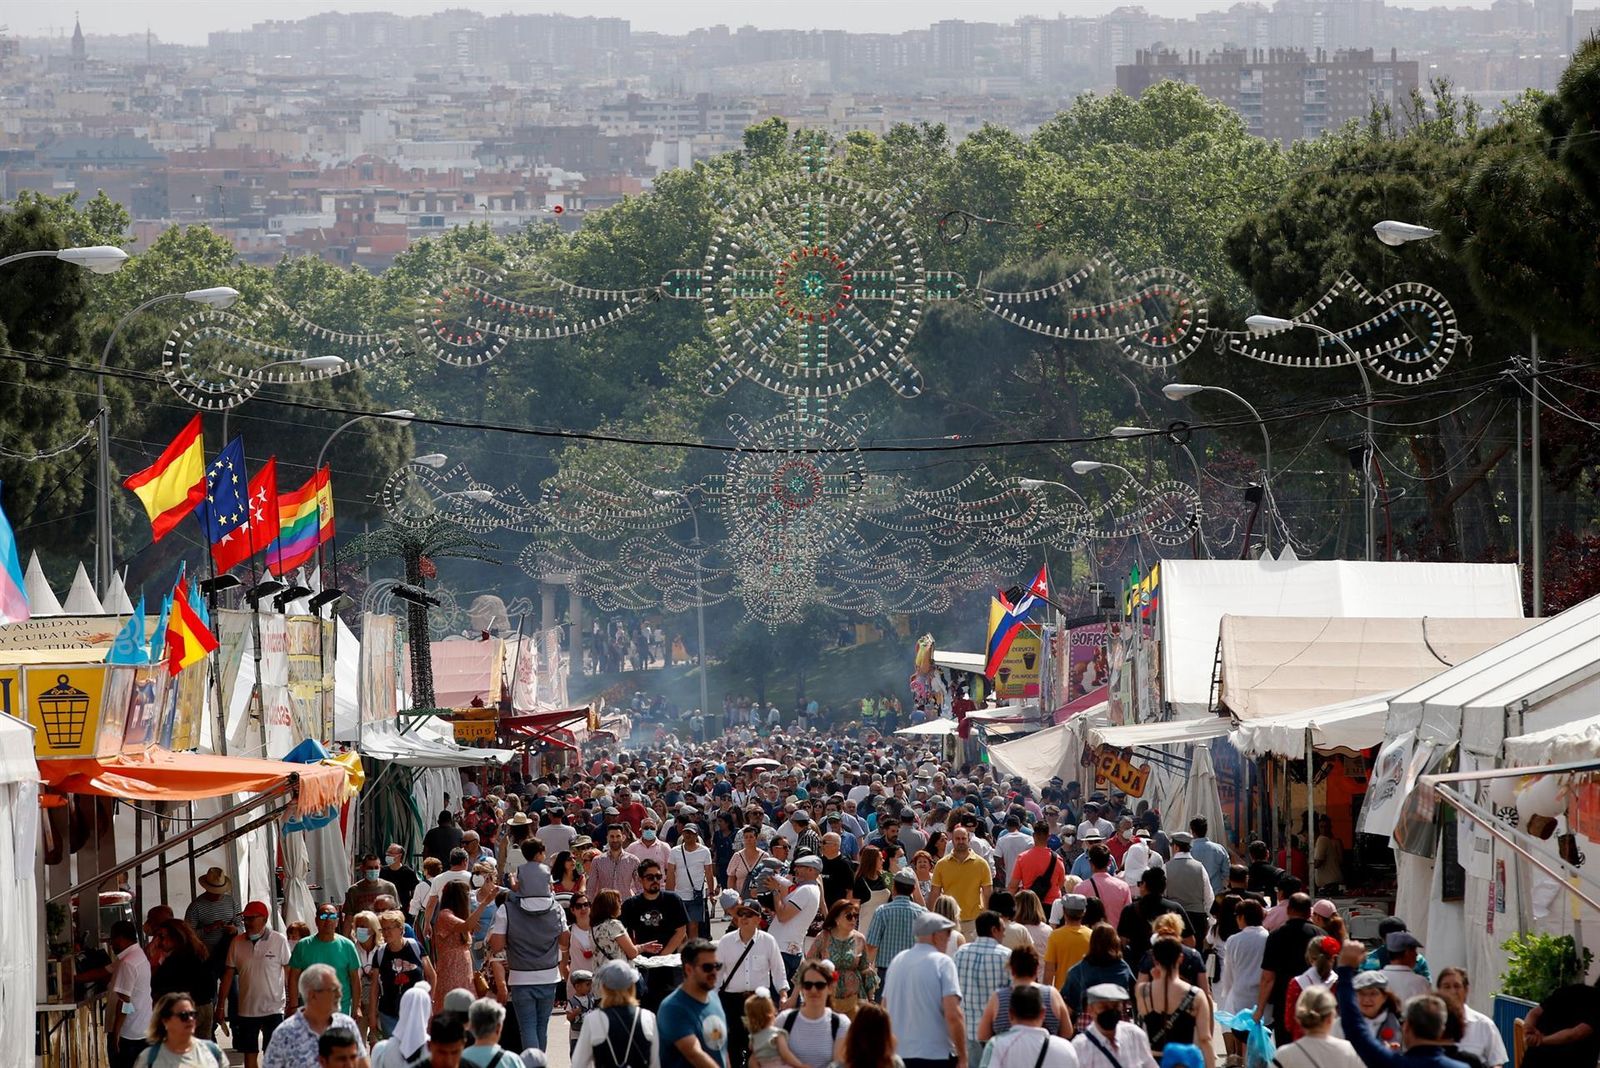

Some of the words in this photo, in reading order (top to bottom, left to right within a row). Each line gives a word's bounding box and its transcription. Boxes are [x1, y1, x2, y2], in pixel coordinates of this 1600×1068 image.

[1, 619, 88, 632] VARIEDAD
[13, 630, 91, 642] CUBATAS
[1102, 757, 1141, 791] CAJA
